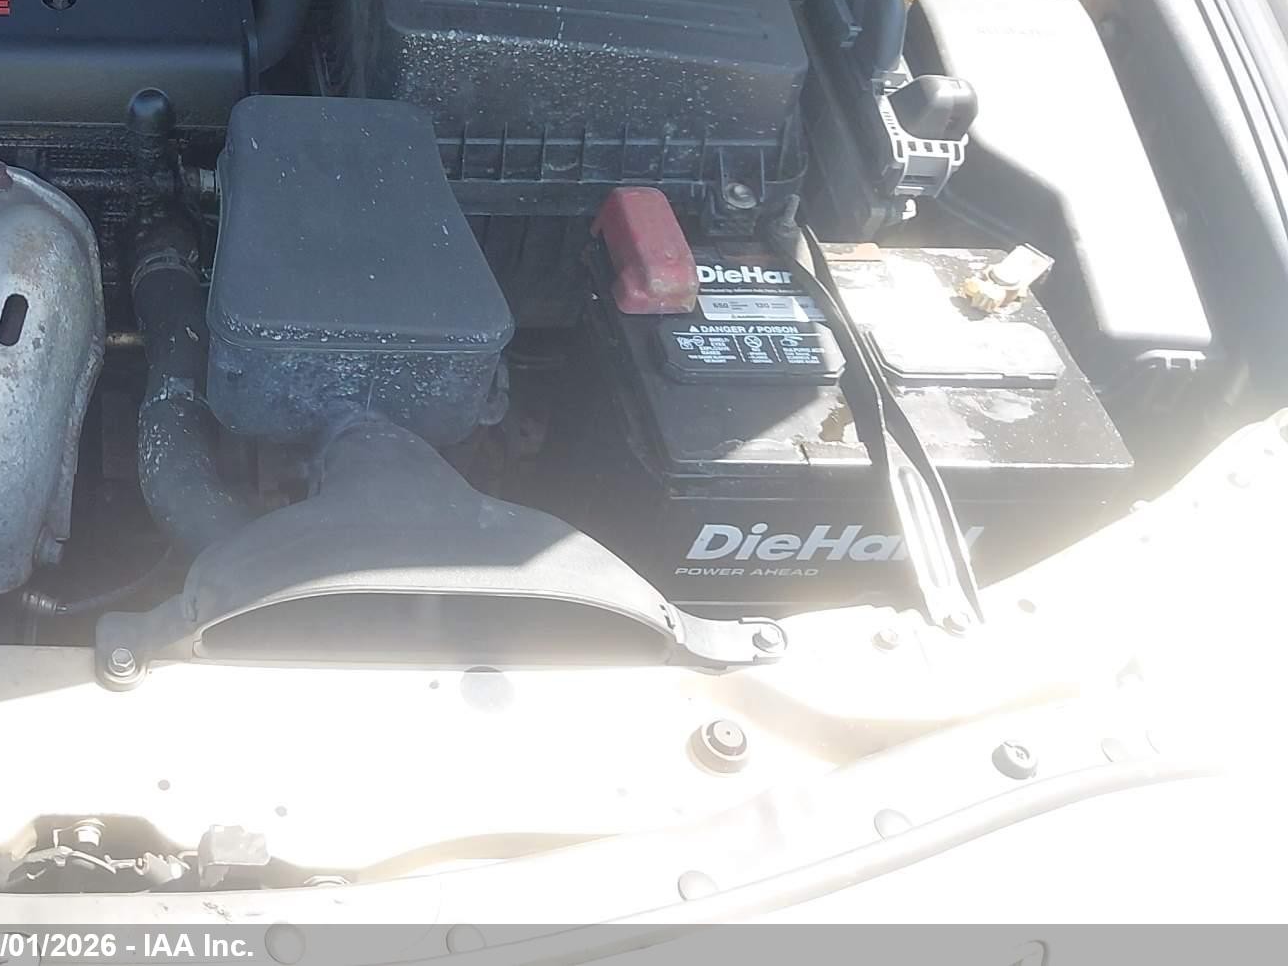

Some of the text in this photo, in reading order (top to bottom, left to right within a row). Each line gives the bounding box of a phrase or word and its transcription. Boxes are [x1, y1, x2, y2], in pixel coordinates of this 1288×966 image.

[696, 264, 792, 283] DieHar
[700, 325, 746, 334] DANGER
[757, 326, 799, 334] POISON
[674, 567, 819, 577] POWER AHEAD
